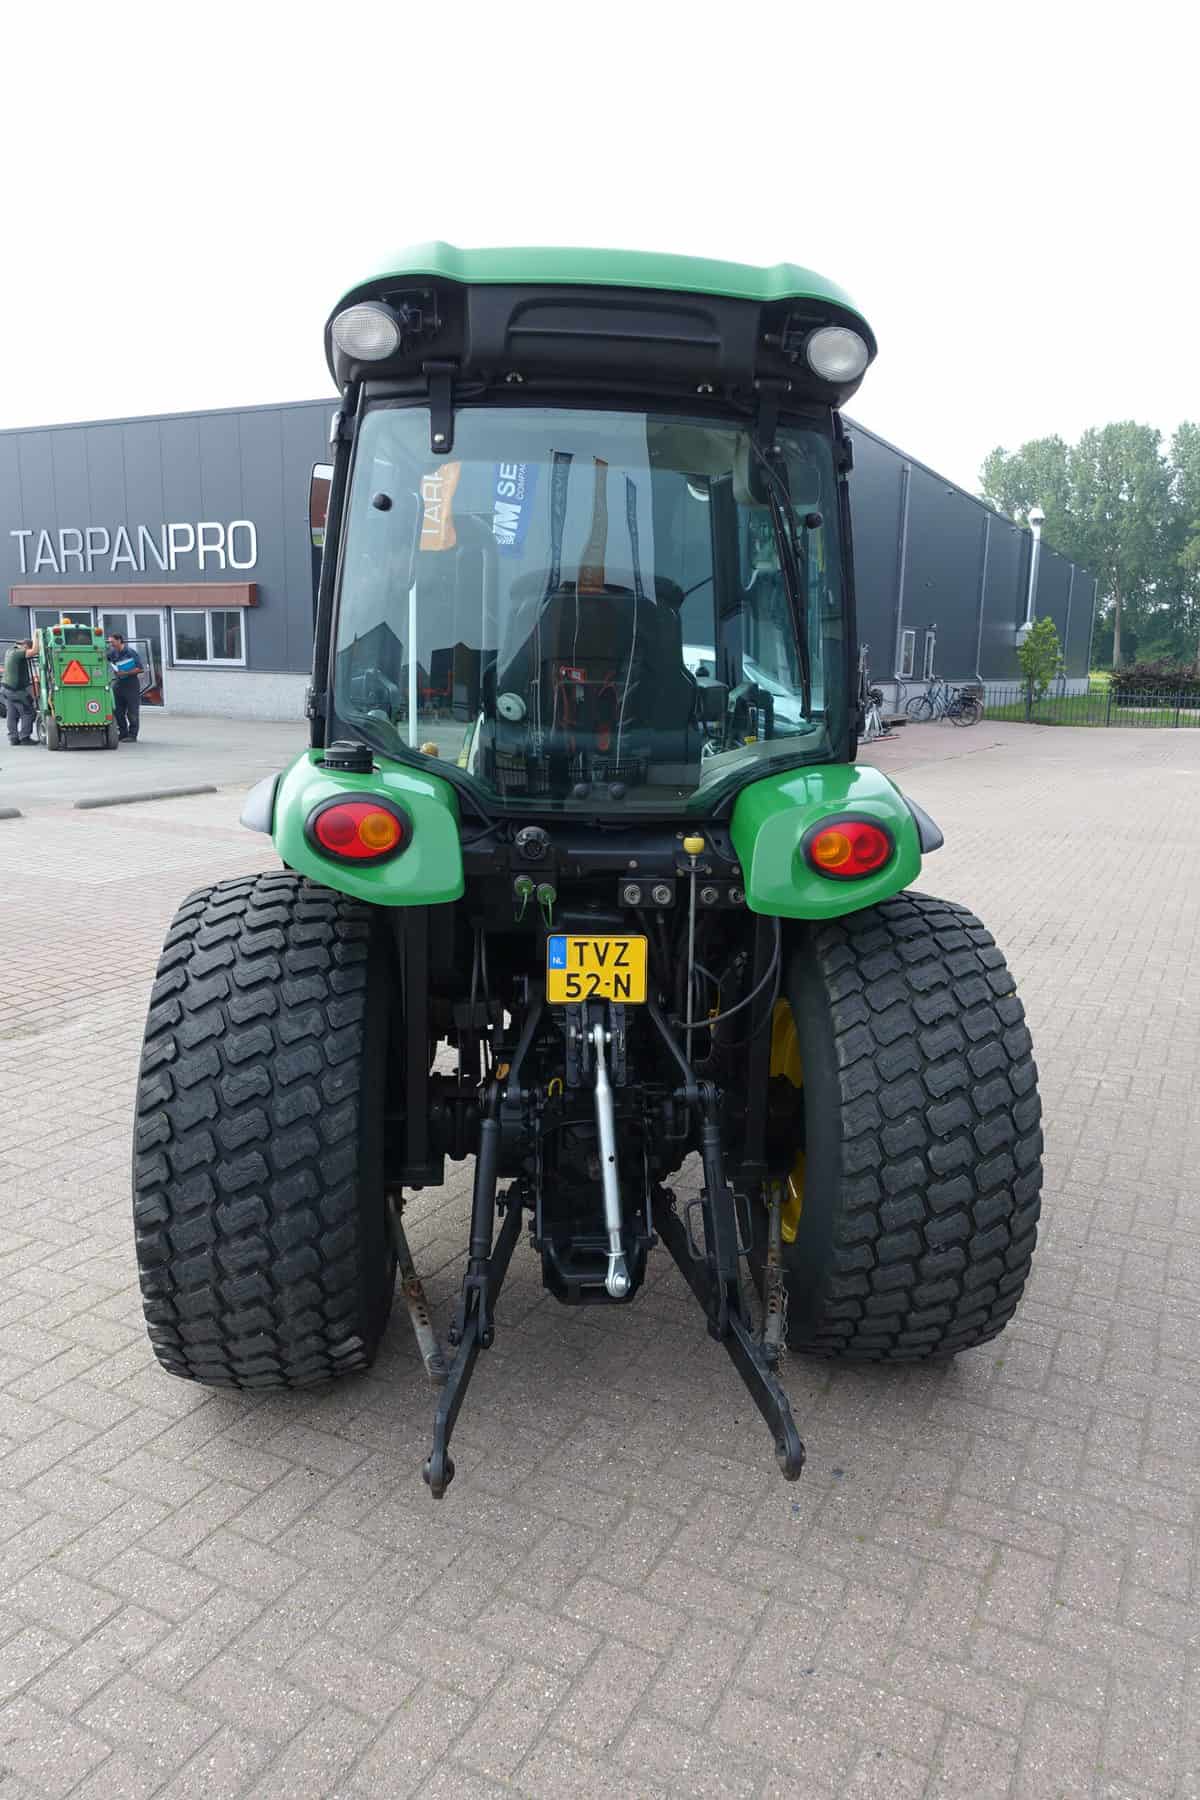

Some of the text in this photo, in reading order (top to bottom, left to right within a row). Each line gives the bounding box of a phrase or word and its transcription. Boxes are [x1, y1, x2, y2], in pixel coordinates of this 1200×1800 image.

[10, 520, 257, 573] TARPANPRO
[552, 956, 564, 965] NL
[573, 942, 629, 966] TVZ
[566, 973, 631, 998] 52-N
